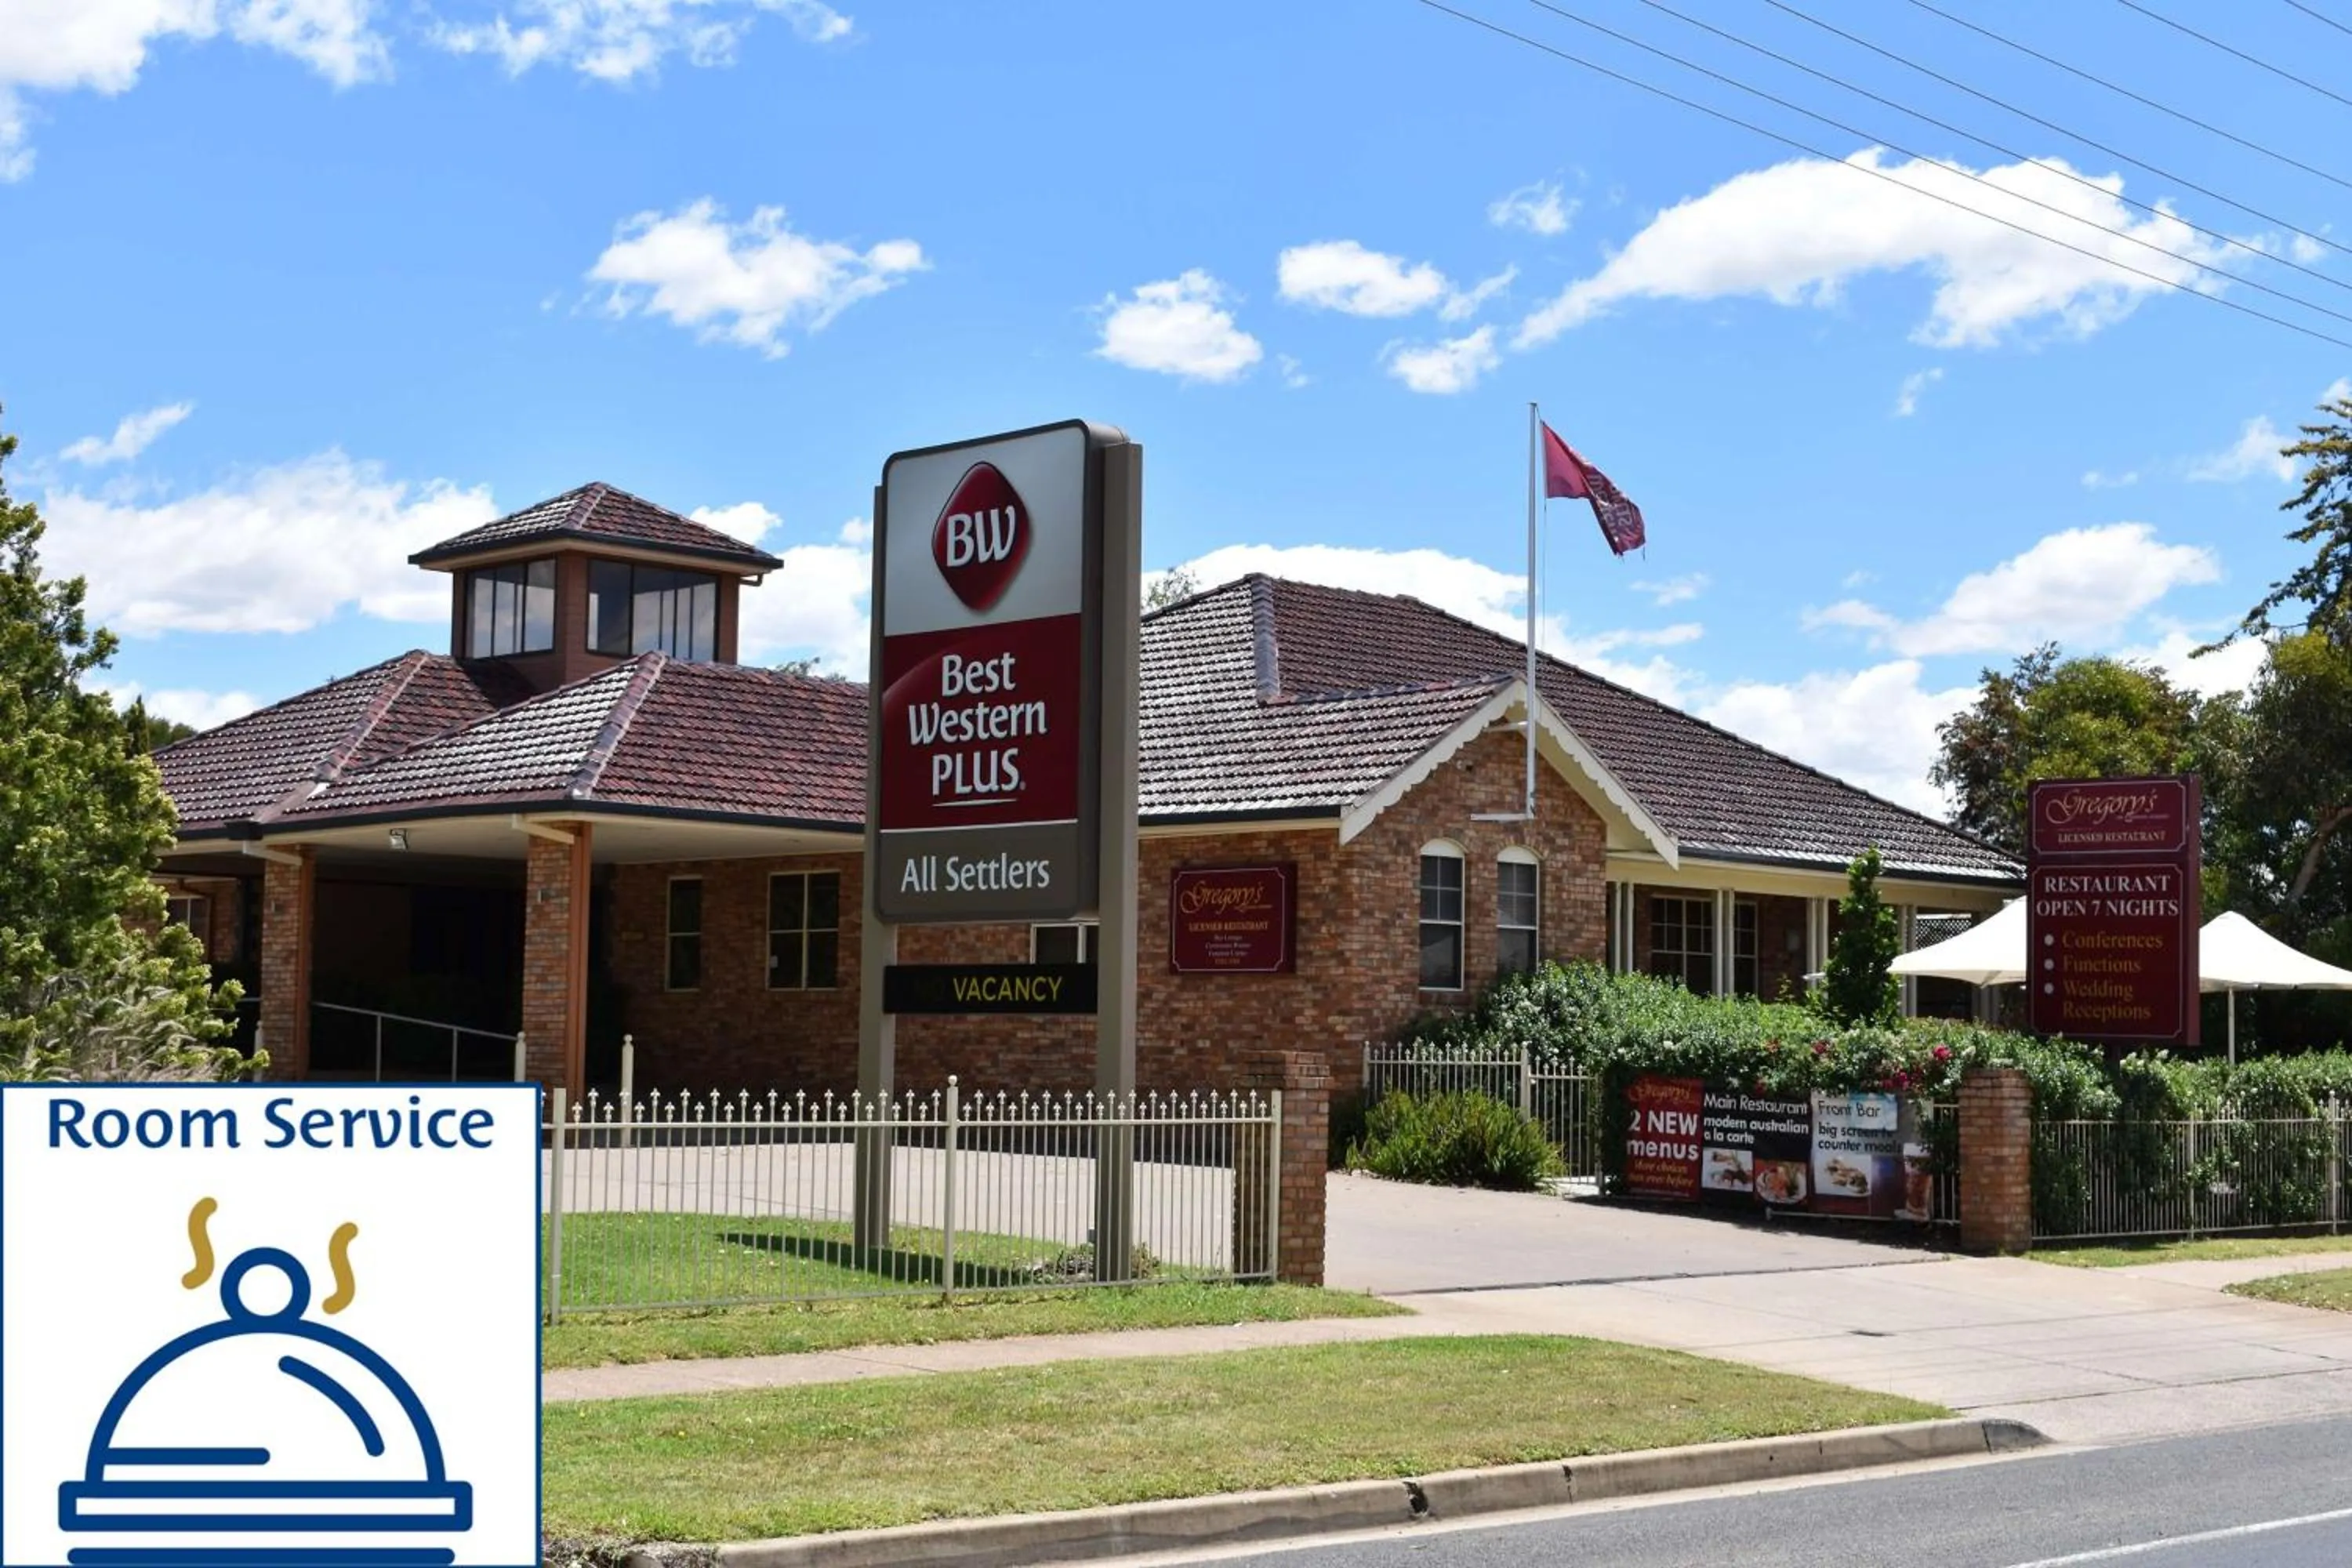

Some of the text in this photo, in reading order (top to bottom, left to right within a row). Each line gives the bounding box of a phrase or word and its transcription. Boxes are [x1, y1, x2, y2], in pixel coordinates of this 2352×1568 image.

[946, 504, 1017, 568] BW
[941, 652, 1016, 699] Best
[908, 699, 1047, 746] Western
[931, 747, 1020, 797] PLUS
[2045, 789, 2165, 824] Gregory's
[2058, 830, 2166, 844] LICENSED RESTAURANT
[900, 853, 1051, 893] All Settlers
[2045, 875, 2171, 893] RESTAURANT
[1180, 880, 1269, 915] Gregory's
[2036, 900, 2180, 917] OPEN 7 NIGHTS
[2062, 931, 2164, 949] Conferences
[2063, 955, 2141, 972] Functions
[953, 975, 1063, 1003] VACANCY
[2063, 982, 2134, 1003] Wedding
[2063, 1002, 2151, 1022] Receptions
[1703, 1092, 1808, 1114] Main Restaurant
[1818, 1100, 1881, 1117] Front Bar
[1628, 1109, 1699, 1136] 2 NEW
[1704, 1116, 1809, 1135] modern australian
[1818, 1121, 1838, 1138] big
[1841, 1126, 1878, 1138] screen
[1704, 1129, 1755, 1145] a la carte
[1818, 1139, 1901, 1153] counter meals
[1626, 1139, 1700, 1161] menus
